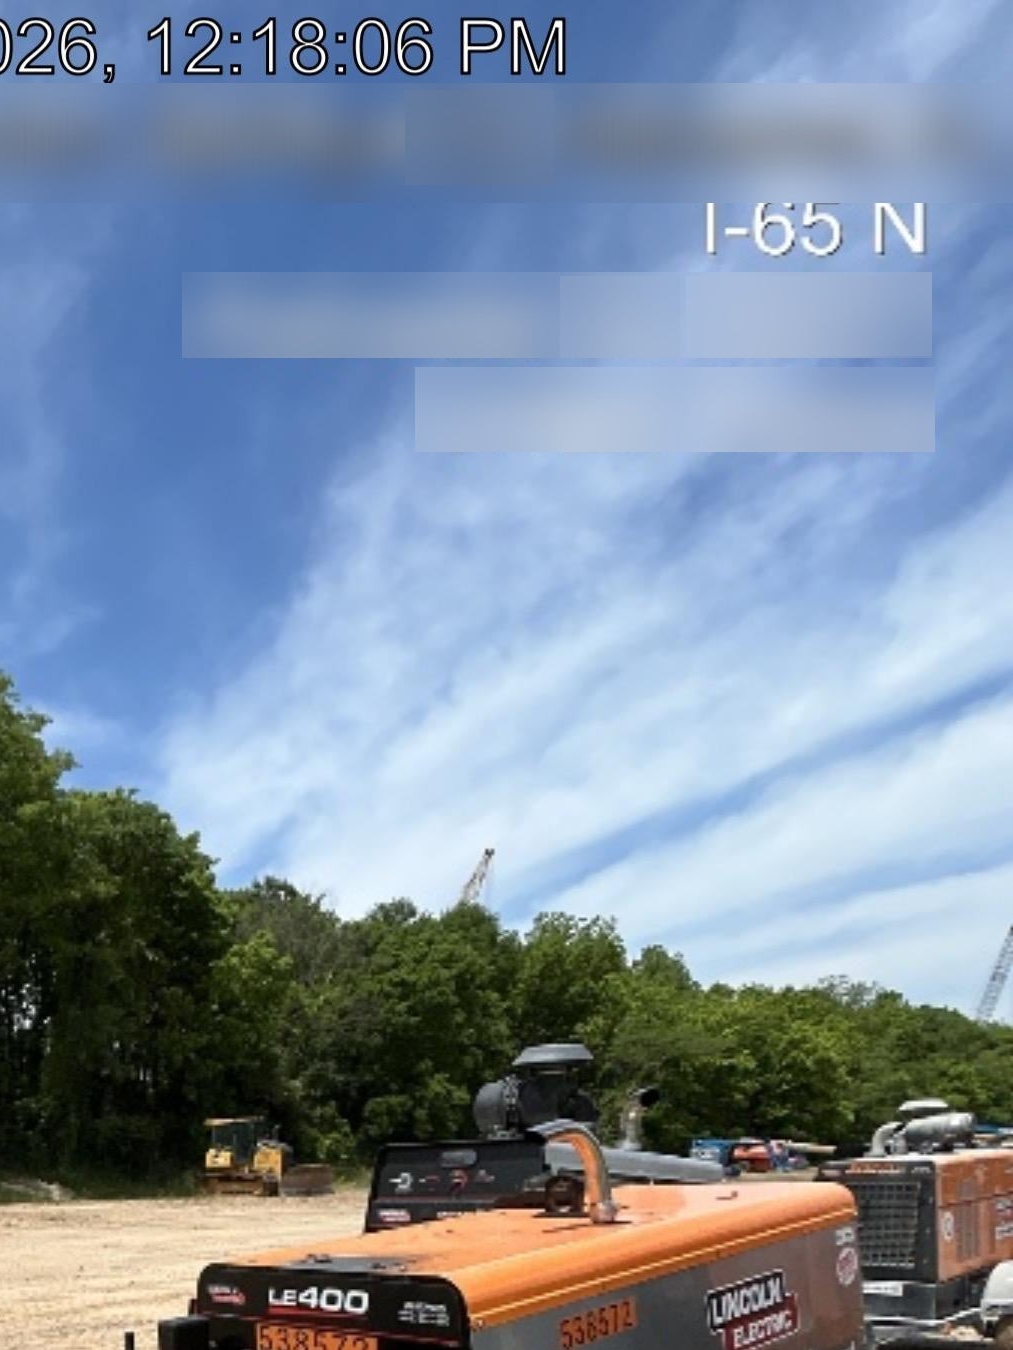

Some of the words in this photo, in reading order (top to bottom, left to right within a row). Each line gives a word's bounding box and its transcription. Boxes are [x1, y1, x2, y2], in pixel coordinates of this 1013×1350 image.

[268, 1286, 370, 1314] LE400
[712, 1278, 783, 1326] LINCOLN
[733, 1311, 793, 1349] ELECTRIC
